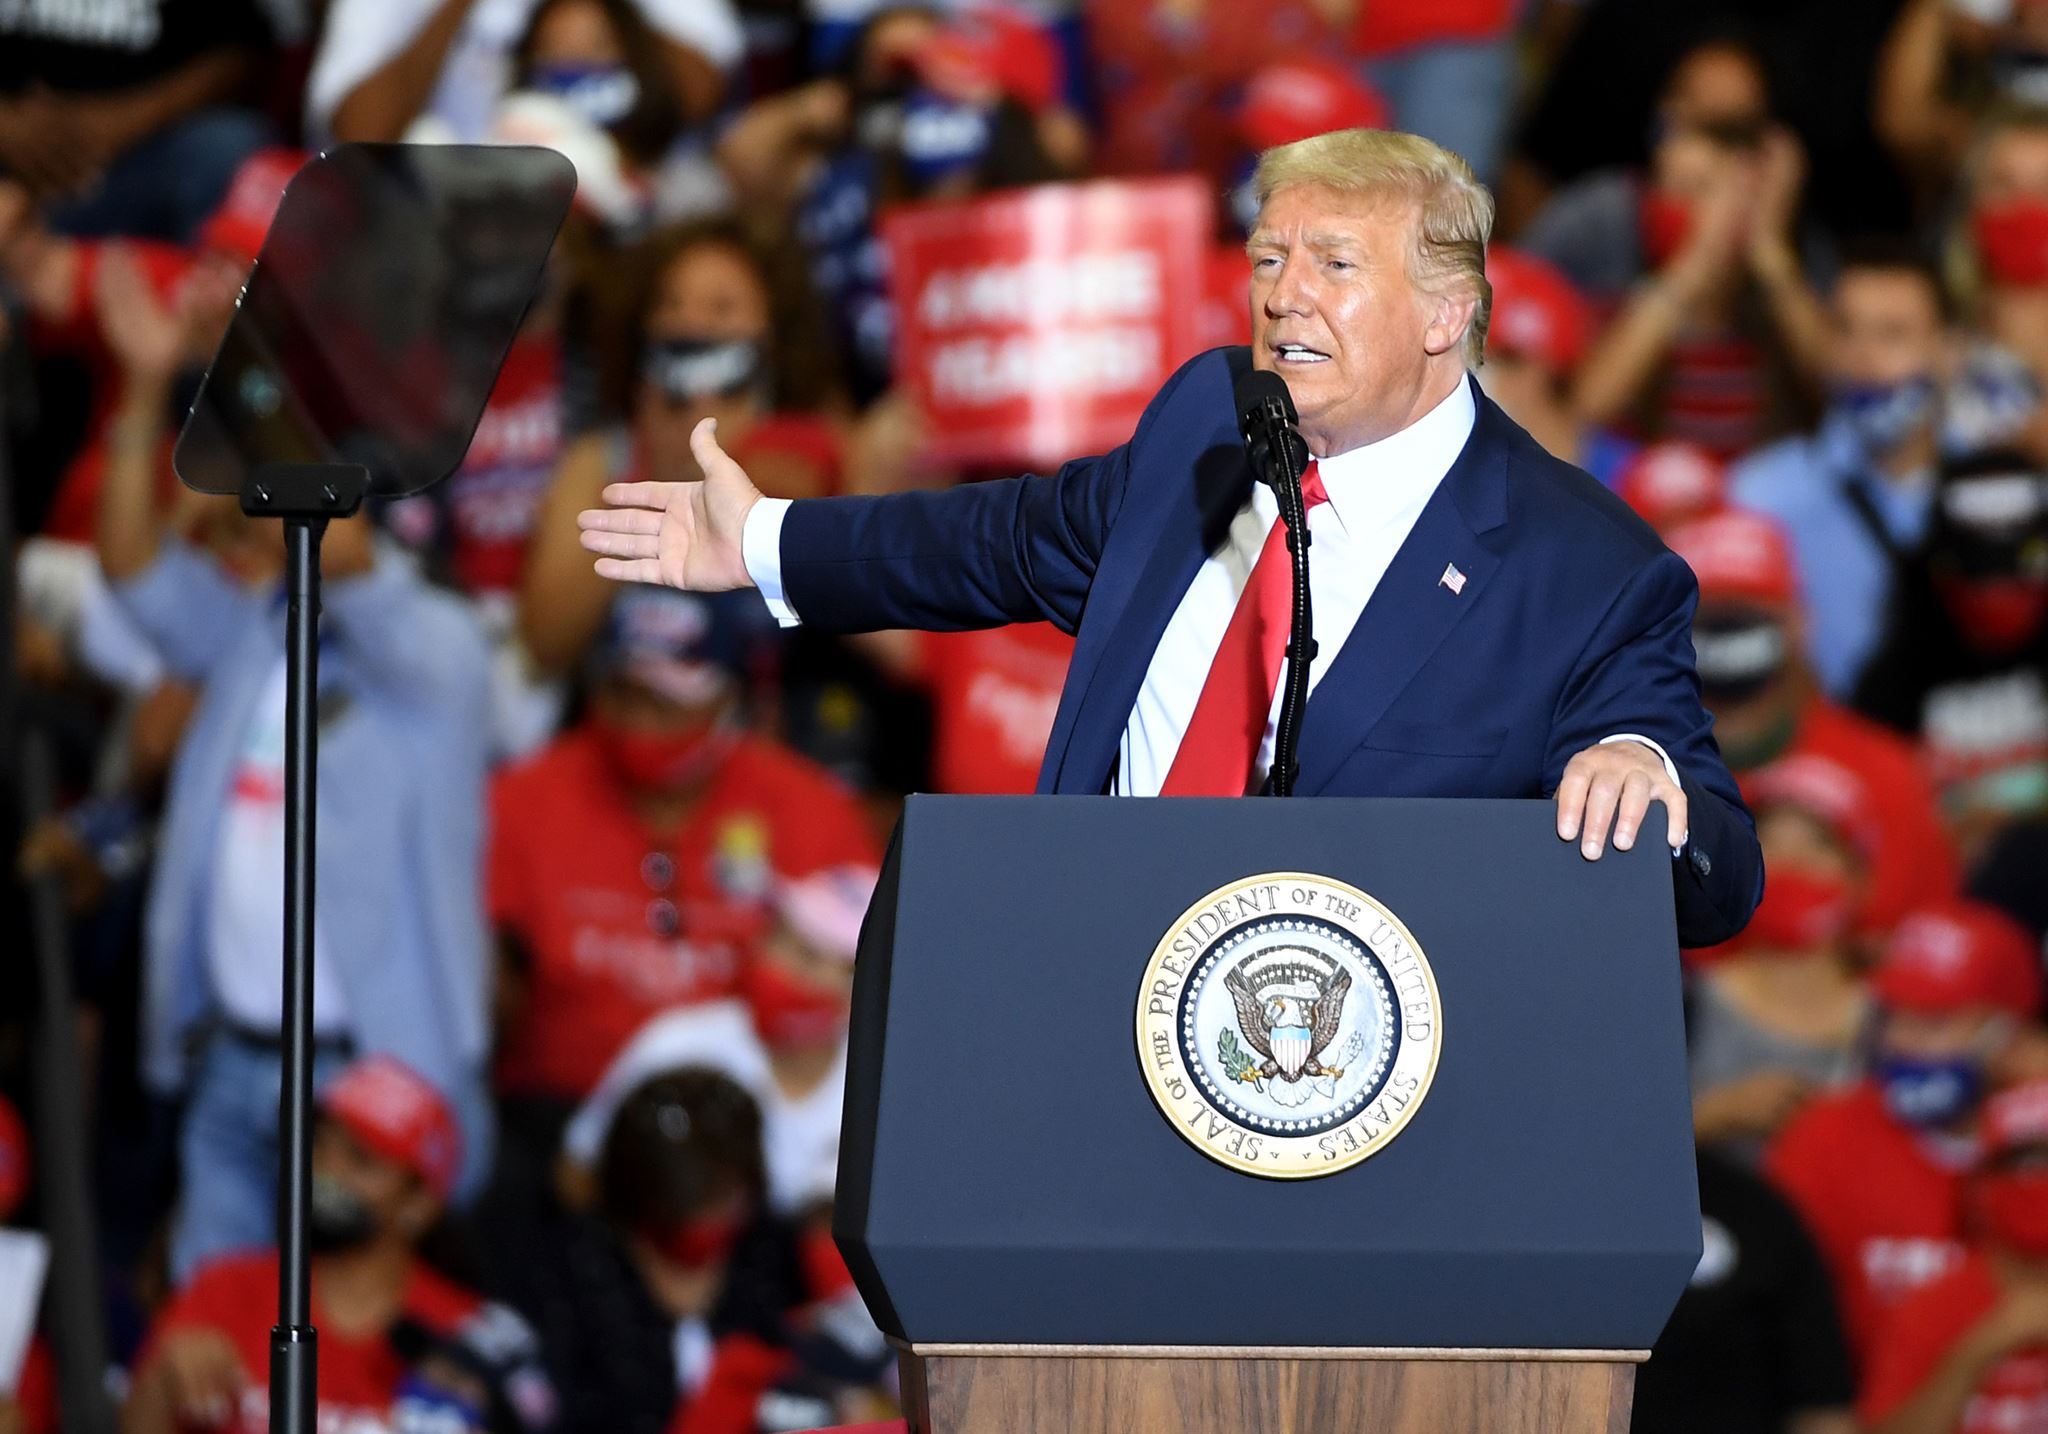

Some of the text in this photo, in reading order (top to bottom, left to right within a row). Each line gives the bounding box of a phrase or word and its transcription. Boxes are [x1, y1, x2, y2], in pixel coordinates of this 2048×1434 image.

[1149, 885, 1431, 1161] SEAL OF THE PRESIDENT OF THE UNITED STATES
